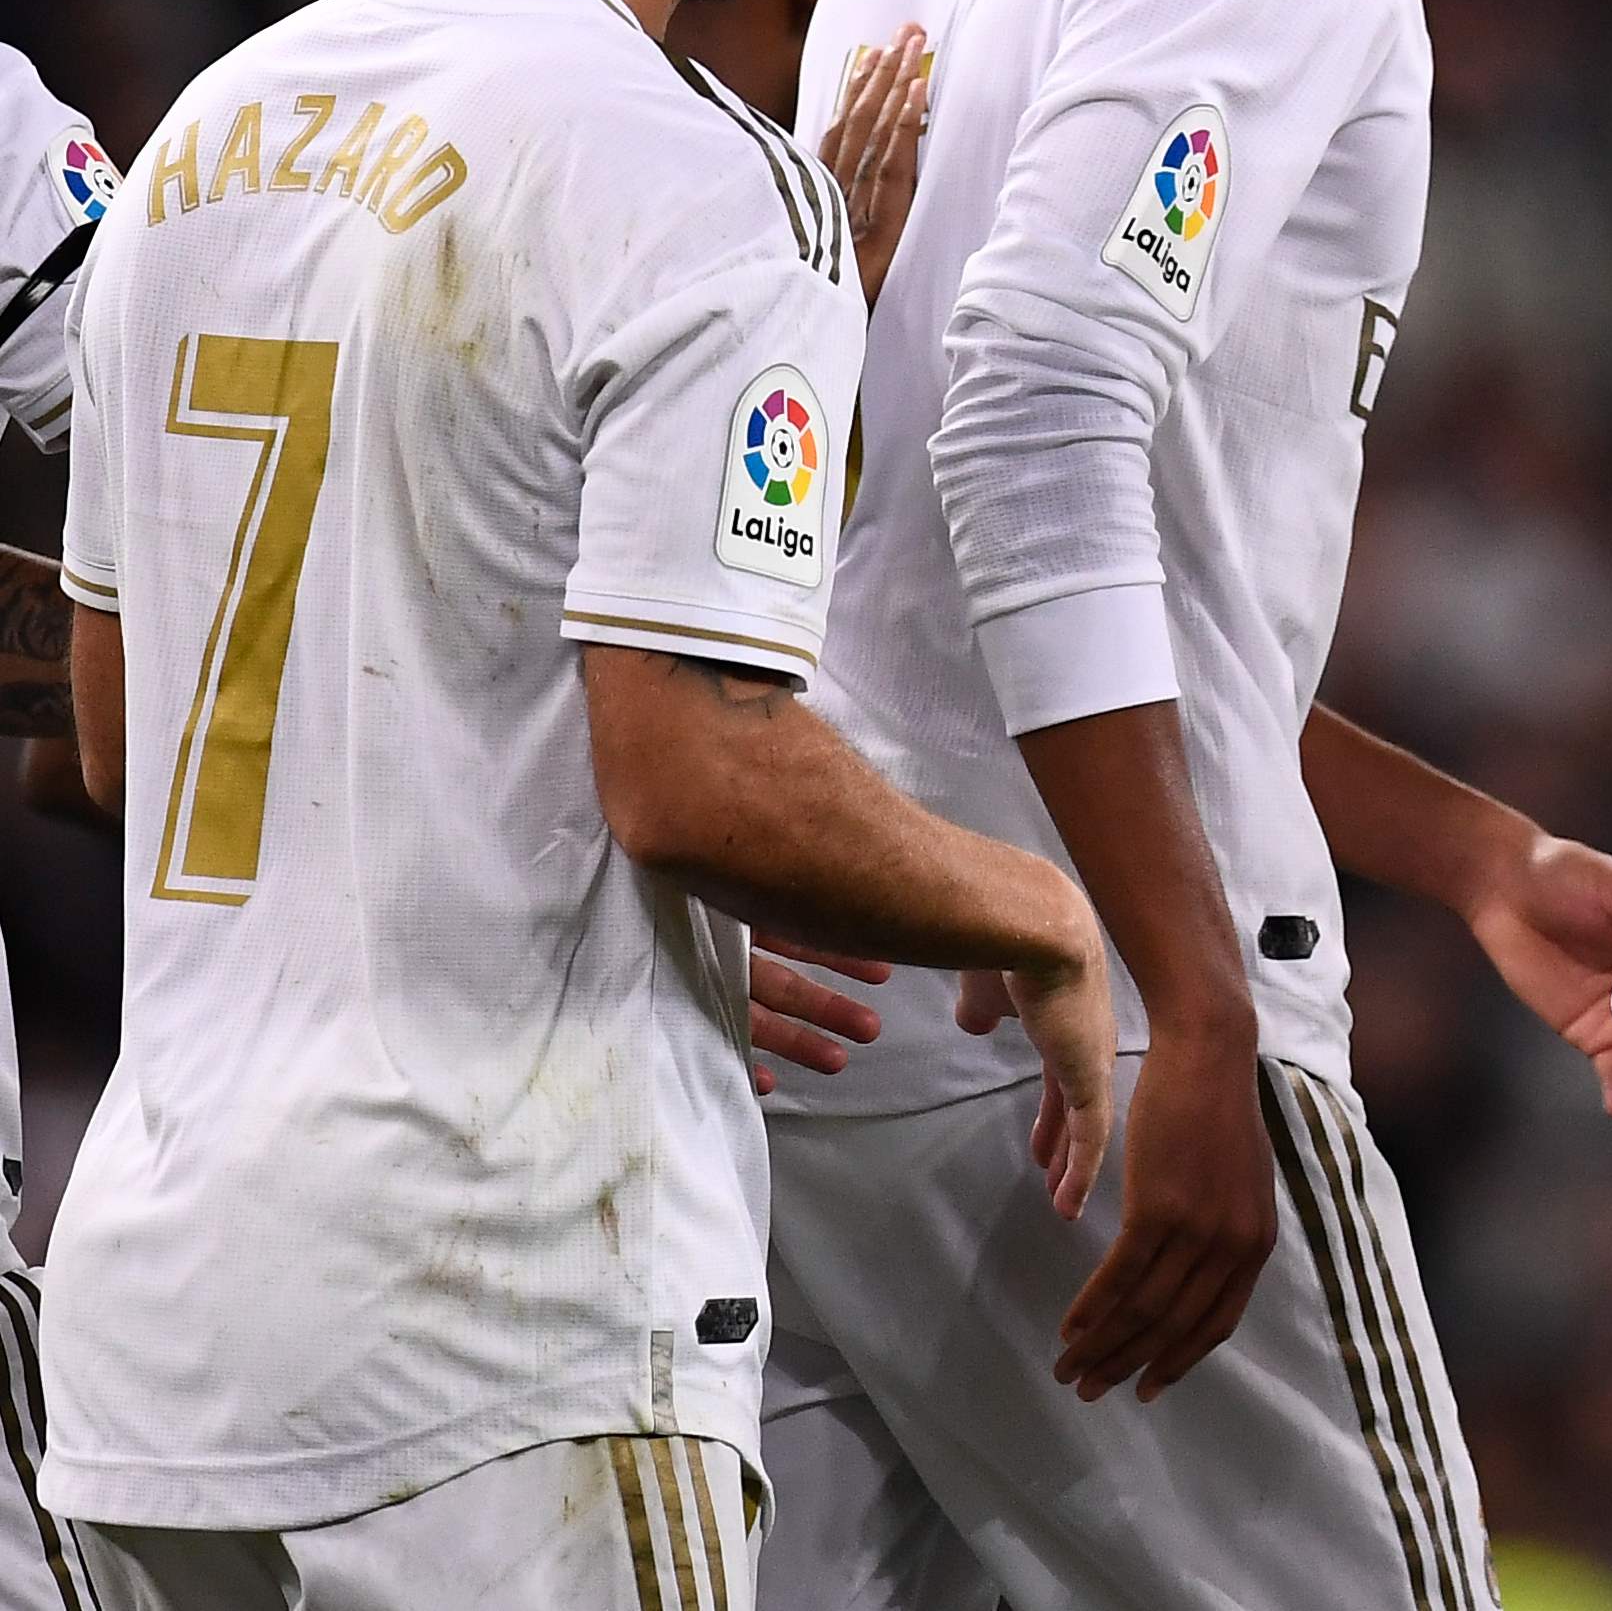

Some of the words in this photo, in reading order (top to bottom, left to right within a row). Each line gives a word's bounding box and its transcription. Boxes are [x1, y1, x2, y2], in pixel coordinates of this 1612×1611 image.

[146, 94, 469, 235] HAZARD
[1121, 216, 1192, 294] LaLiga
[731, 507, 814, 558] LaLiga
[150, 333, 340, 908] 7
